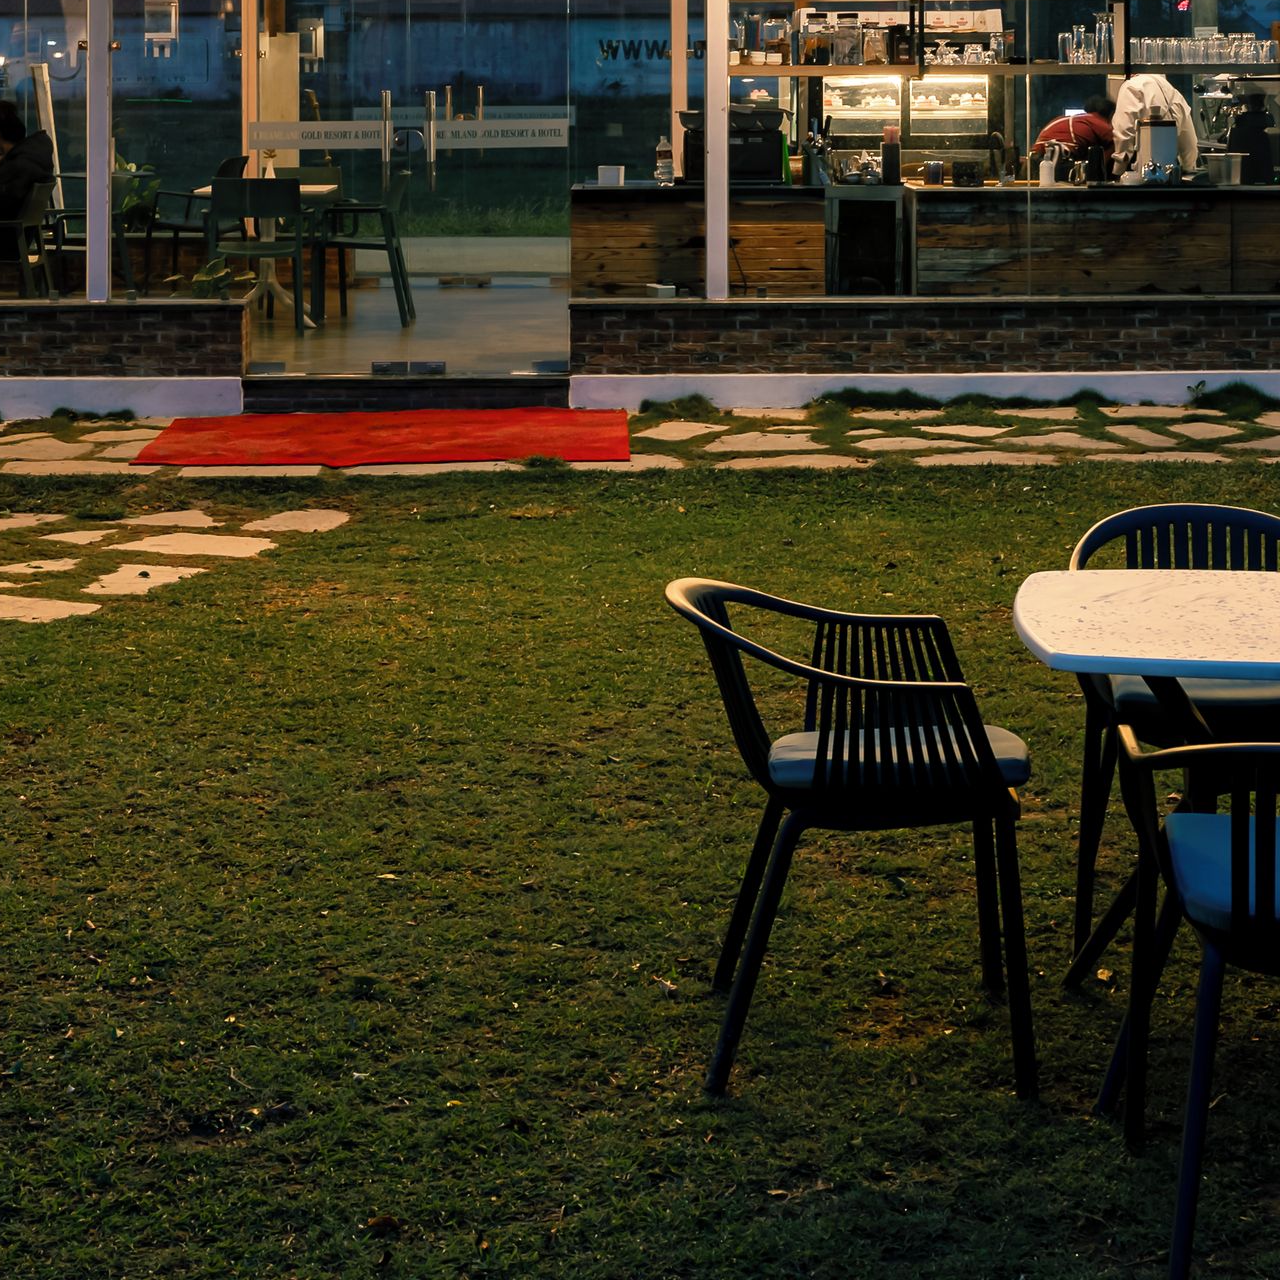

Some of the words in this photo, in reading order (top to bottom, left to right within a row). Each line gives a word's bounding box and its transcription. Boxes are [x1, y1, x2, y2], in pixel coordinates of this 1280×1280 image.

[301, 130, 322, 140] GOLD
[323, 130, 352, 140] RESORT
[353, 130, 361, 140] &
[361, 130, 382, 140] HOTE
[500, 128, 529, 138] RESORT
[530, 128, 537, 138] &
[537, 128, 563, 138] HOTEL
